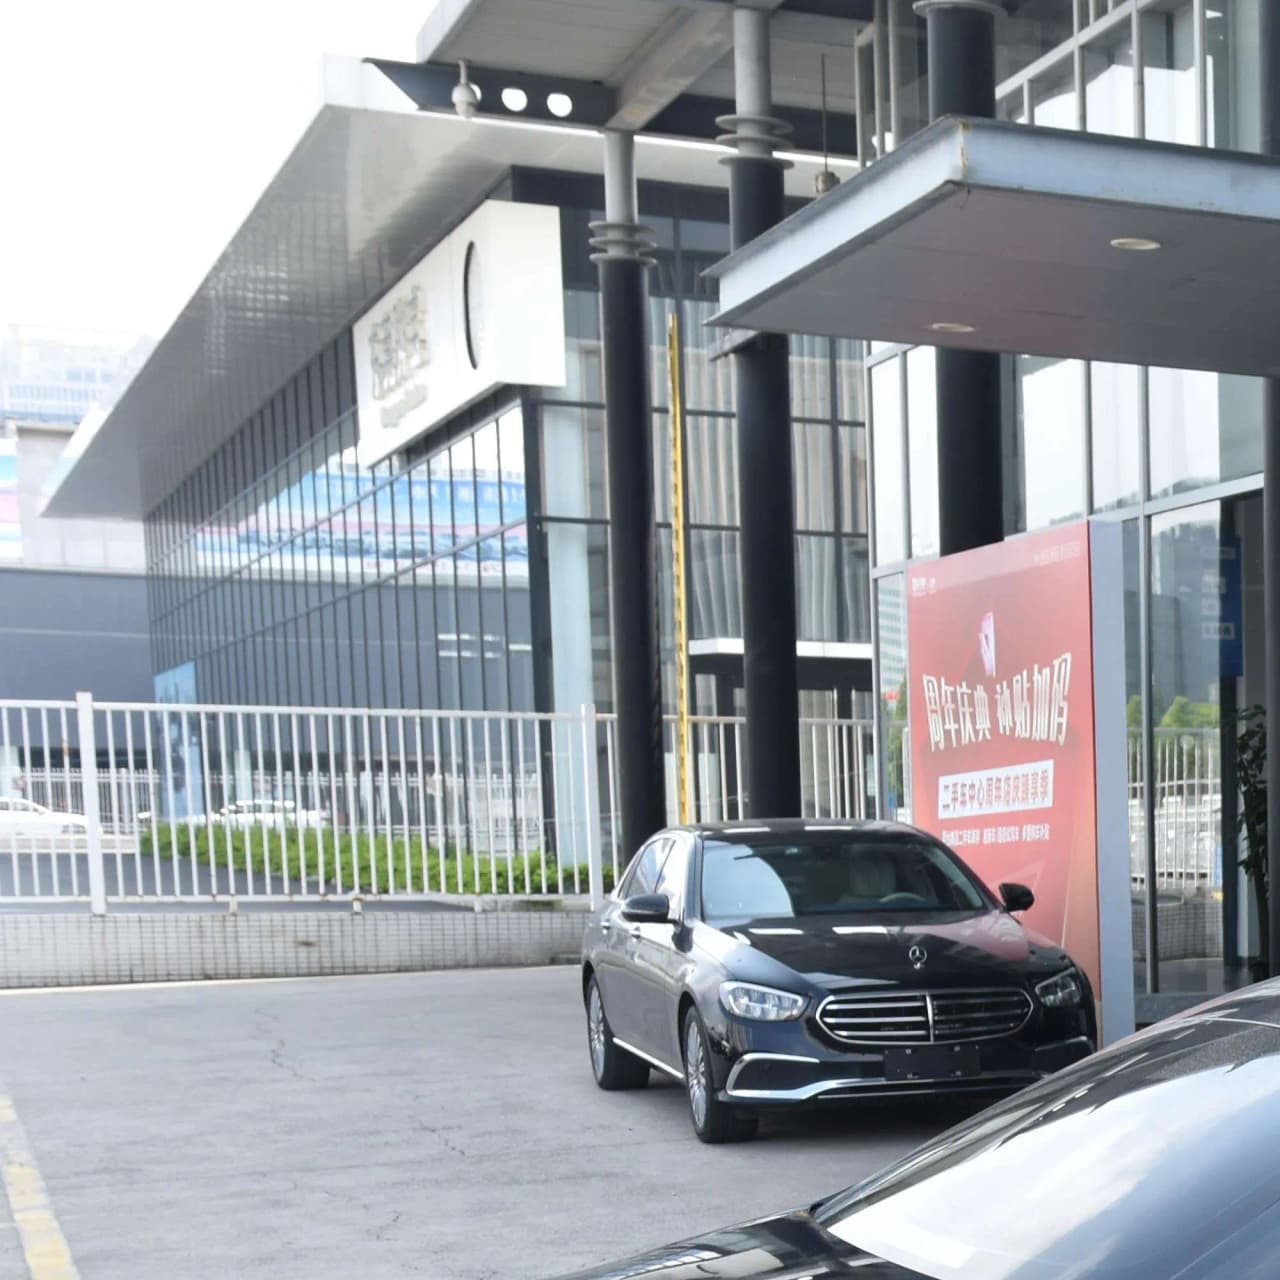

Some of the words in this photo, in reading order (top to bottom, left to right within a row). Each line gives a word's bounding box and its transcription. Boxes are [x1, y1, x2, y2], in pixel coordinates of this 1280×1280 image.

[922, 673, 992, 753] 周年庆典
[996, 652, 1072, 747] 补贴加码
